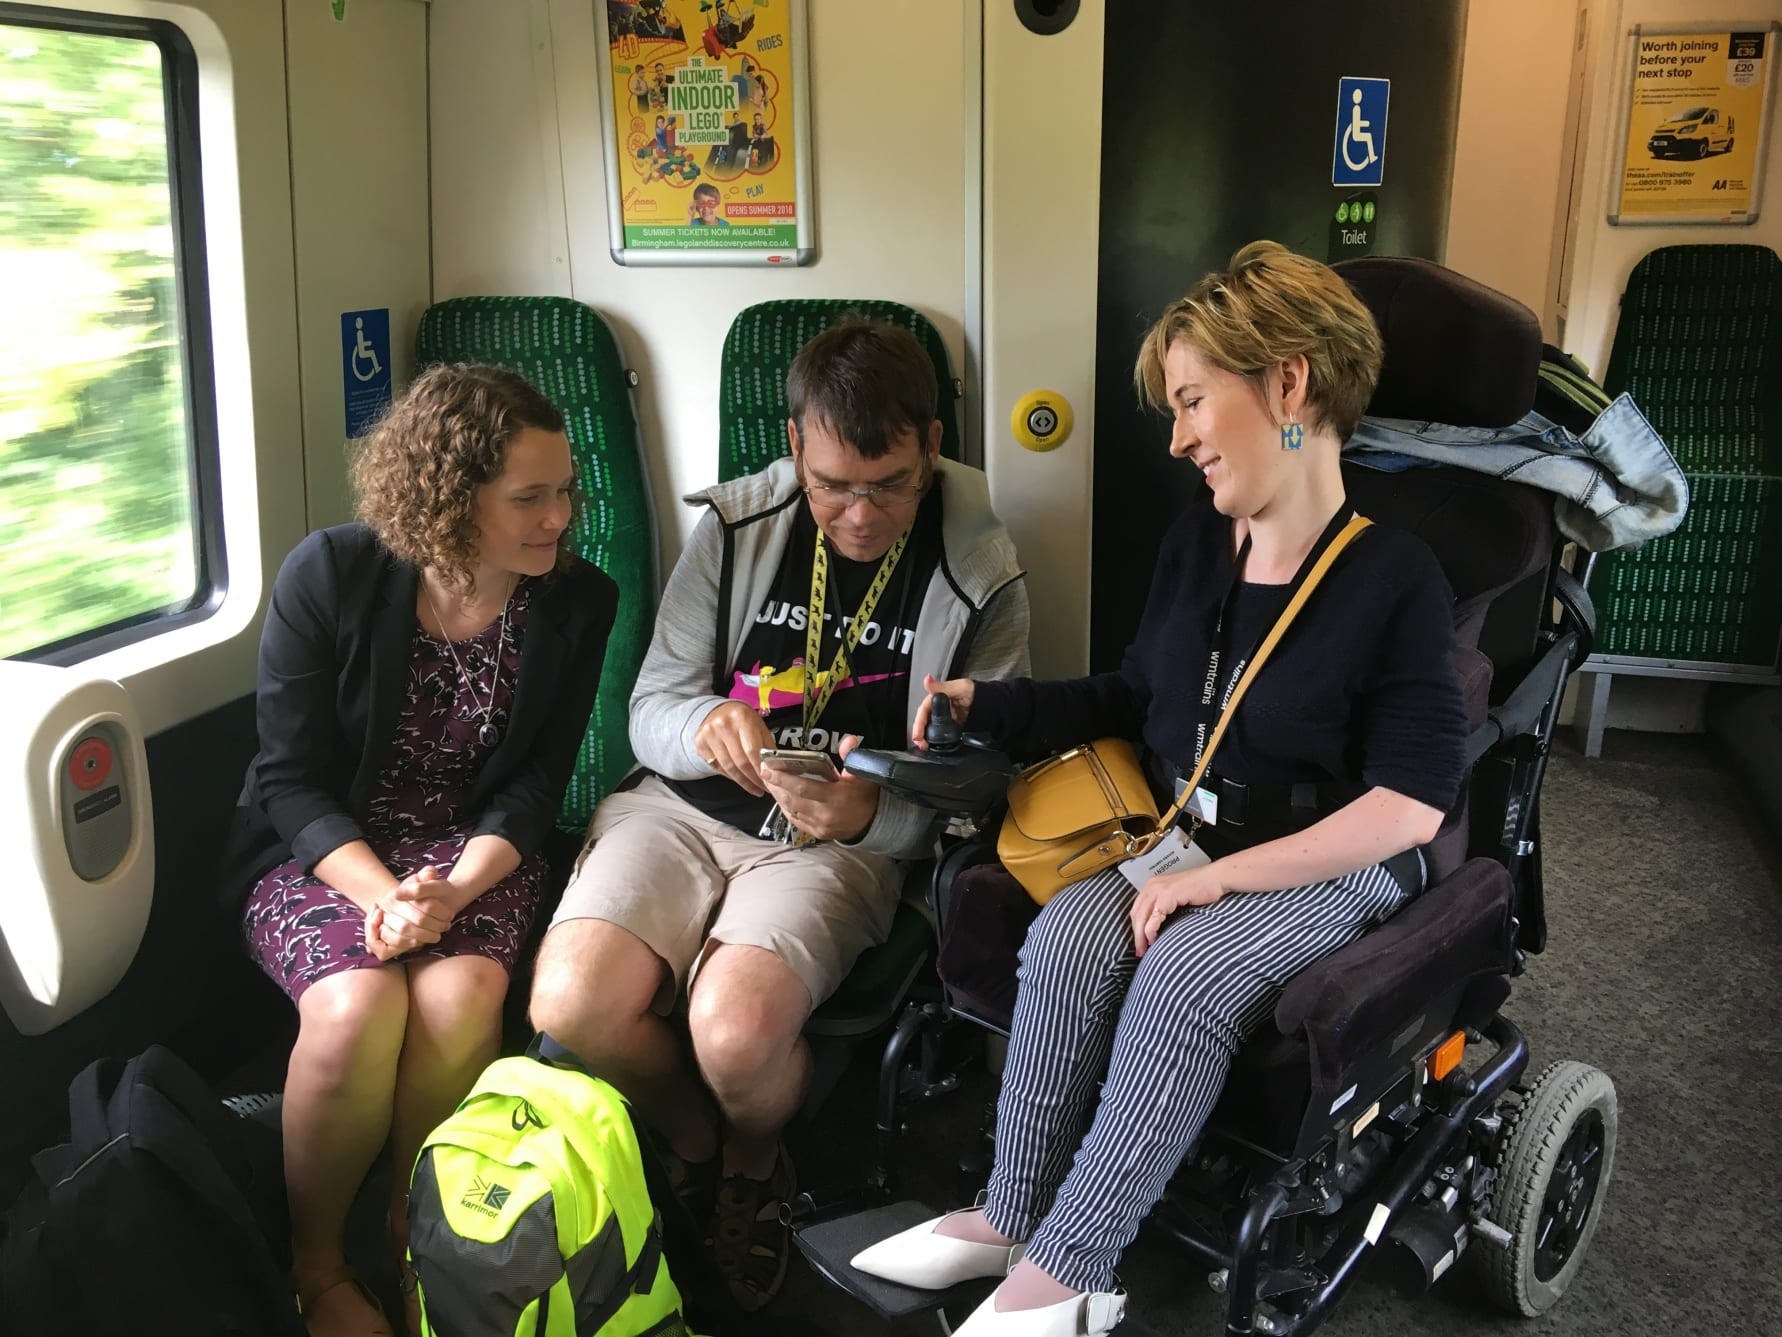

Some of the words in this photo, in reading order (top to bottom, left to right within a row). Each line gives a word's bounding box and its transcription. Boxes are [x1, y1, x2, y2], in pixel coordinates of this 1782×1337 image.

[757, 34, 783, 52] RIDES
[1641, 41, 1677, 52] Worth
[1680, 40, 1719, 53] joining
[1736, 47, 1756, 57] £39
[691, 58, 703, 67] THE
[1639, 55, 1677, 66] before
[1680, 55, 1706, 68] your
[1734, 63, 1754, 73] £20
[678, 70, 723, 84] ULTIMATE
[1638, 67, 1664, 79] next
[1666, 67, 1693, 80] stop
[672, 86, 735, 110] INDOOR
[689, 112, 720, 130] LEGO
[678, 131, 727, 143] PLAYGROUND
[746, 184, 764, 198] PLAY
[1712, 180, 1728, 190] AA
[727, 206, 747, 215] OPENS
[749, 205, 776, 215] SUMMER
[777, 205, 793, 214] 2018
[642, 229, 676, 237] SUMMER
[678, 228, 709, 236] TICKETS
[711, 228, 730, 236] NOW
[732, 228, 776, 236] AVAILABLE!
[1341, 229, 1367, 245] Toilet
[756, 600, 832, 631] JUS
[460, 1198, 499, 1219] karrimor
